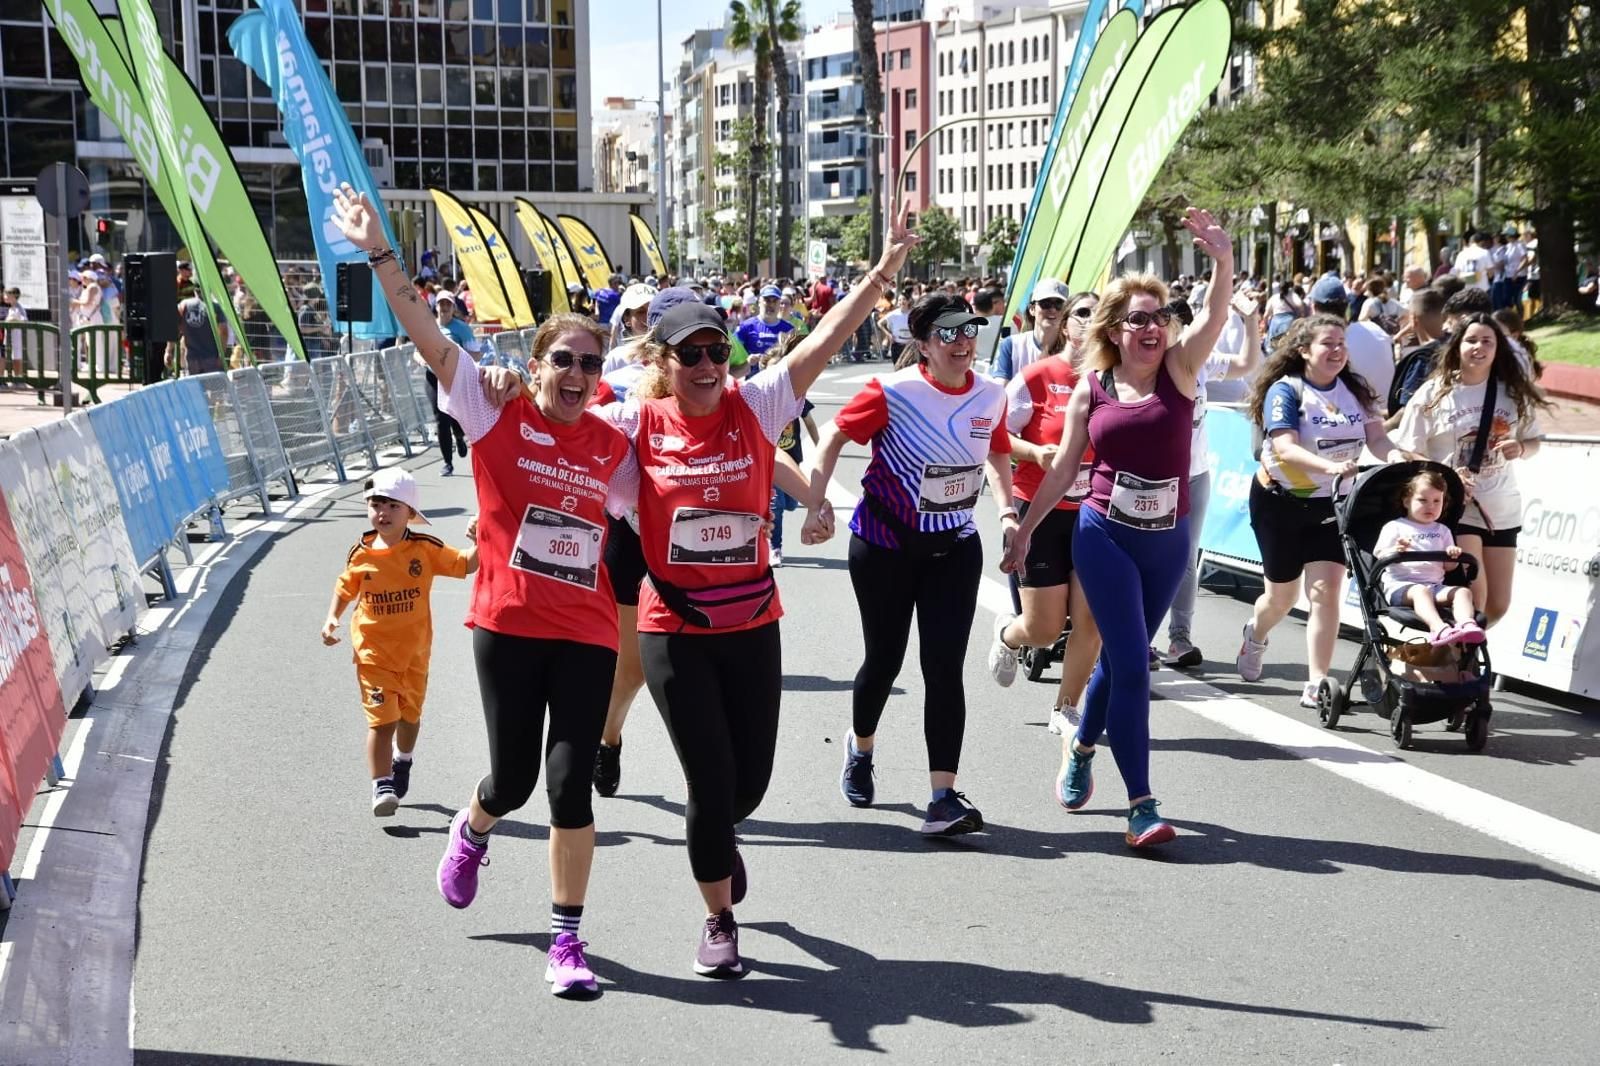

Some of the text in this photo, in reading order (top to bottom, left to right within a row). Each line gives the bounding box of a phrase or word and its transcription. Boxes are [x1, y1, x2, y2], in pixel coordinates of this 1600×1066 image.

[1126, 61, 1206, 204] Binter
[517, 457, 557, 478] CARRERA
[558, 469, 570, 481] DE
[570, 472, 584, 486] LAS
[704, 462, 720, 474] LAS
[529, 474, 540, 484] LAS
[541, 477, 565, 491] PALMAS
[565, 483, 573, 492] DE
[679, 477, 701, 486] PALMAS
[702, 477, 710, 485] DE
[944, 483, 965, 496] 2371
[1134, 500, 1159, 511] 2375
[1522, 498, 1577, 542] Gran
[700, 526, 732, 542] 3749
[549, 540, 579, 557] 3020
[1527, 552, 1579, 575] Europea
[365, 586, 421, 604] Emirates
[373, 600, 414, 616] FLY BETTER
